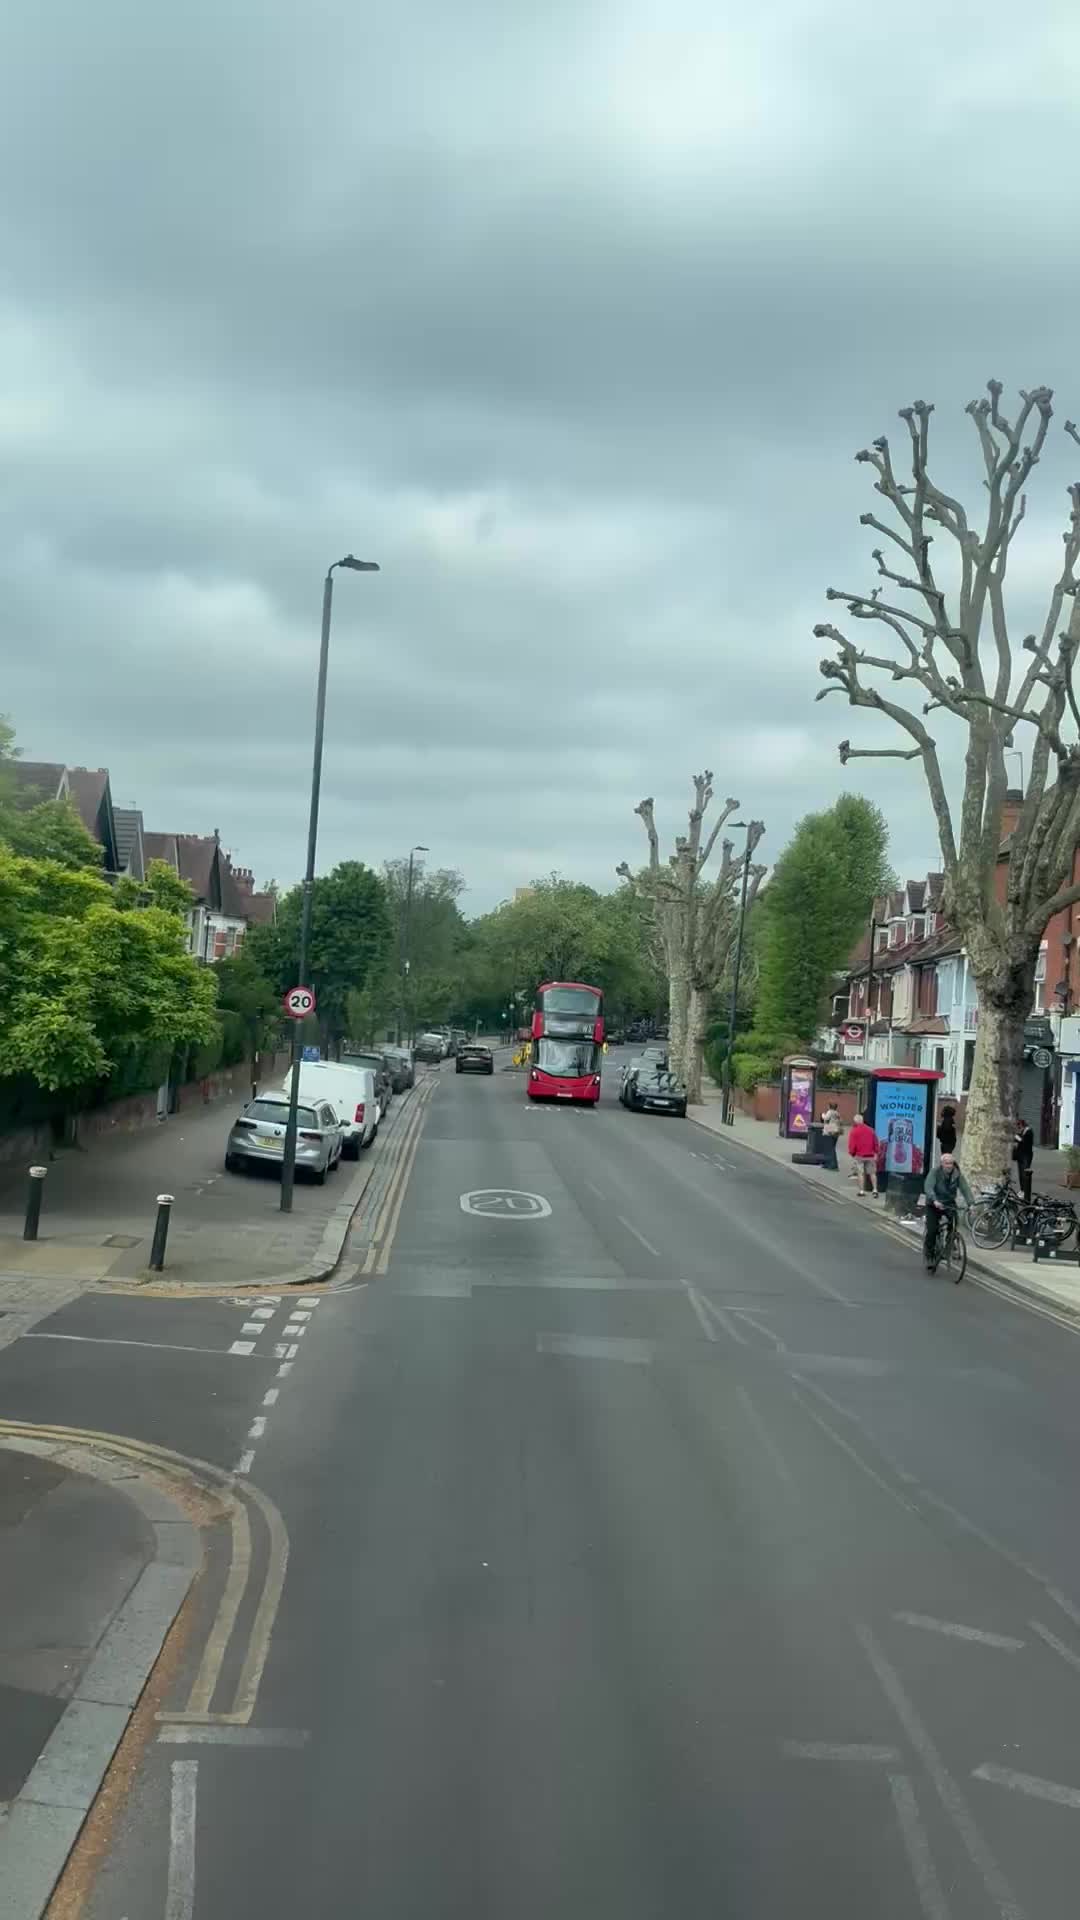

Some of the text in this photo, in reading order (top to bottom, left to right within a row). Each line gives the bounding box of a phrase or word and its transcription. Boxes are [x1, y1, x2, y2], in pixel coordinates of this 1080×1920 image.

[291, 995, 312, 1009] 20
[880, 1101, 923, 1112] WONDER
[471, 1197, 539, 1210] 20
